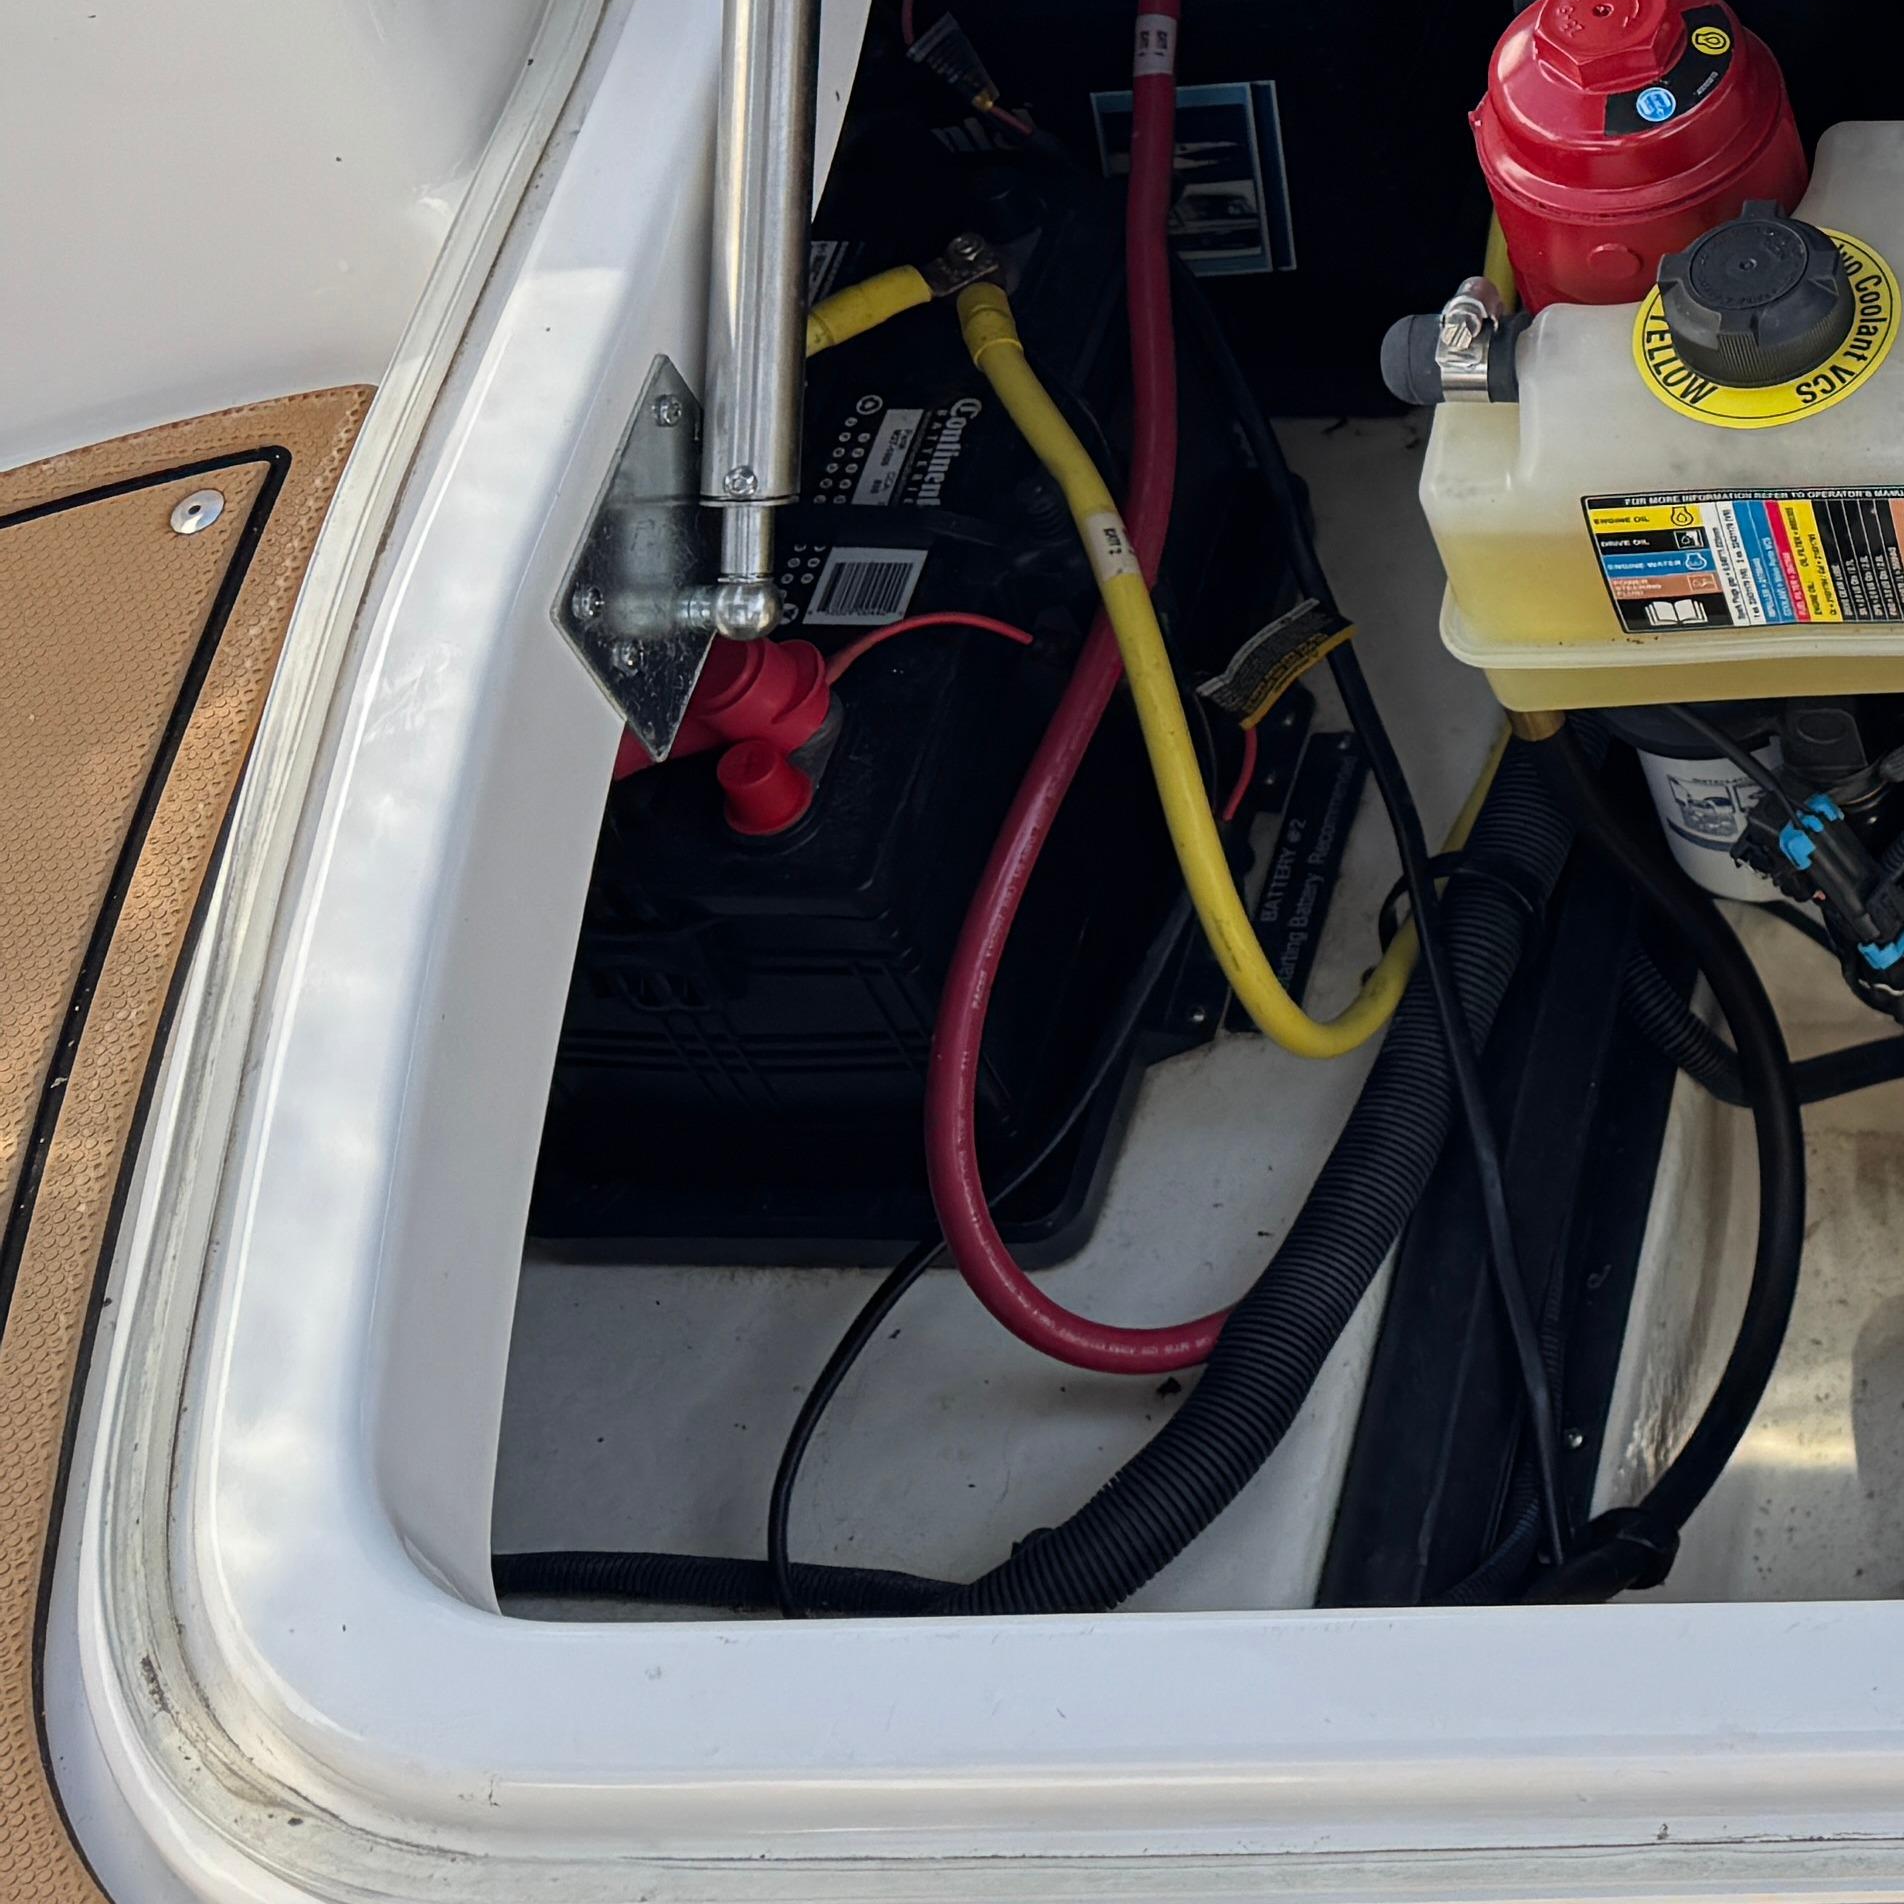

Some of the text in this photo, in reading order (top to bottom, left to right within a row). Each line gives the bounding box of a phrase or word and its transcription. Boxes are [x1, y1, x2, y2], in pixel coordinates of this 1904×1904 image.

[1795, 274, 1887, 404] Coolant VCS
[1624, 498, 1646, 507] FOR
[1650, 496, 1680, 505] MORE
[1682, 493, 1752, 504] INFORMATION
[1260, 847, 1296, 923] BATTERY
[1289, 871, 1323, 928] Battery
